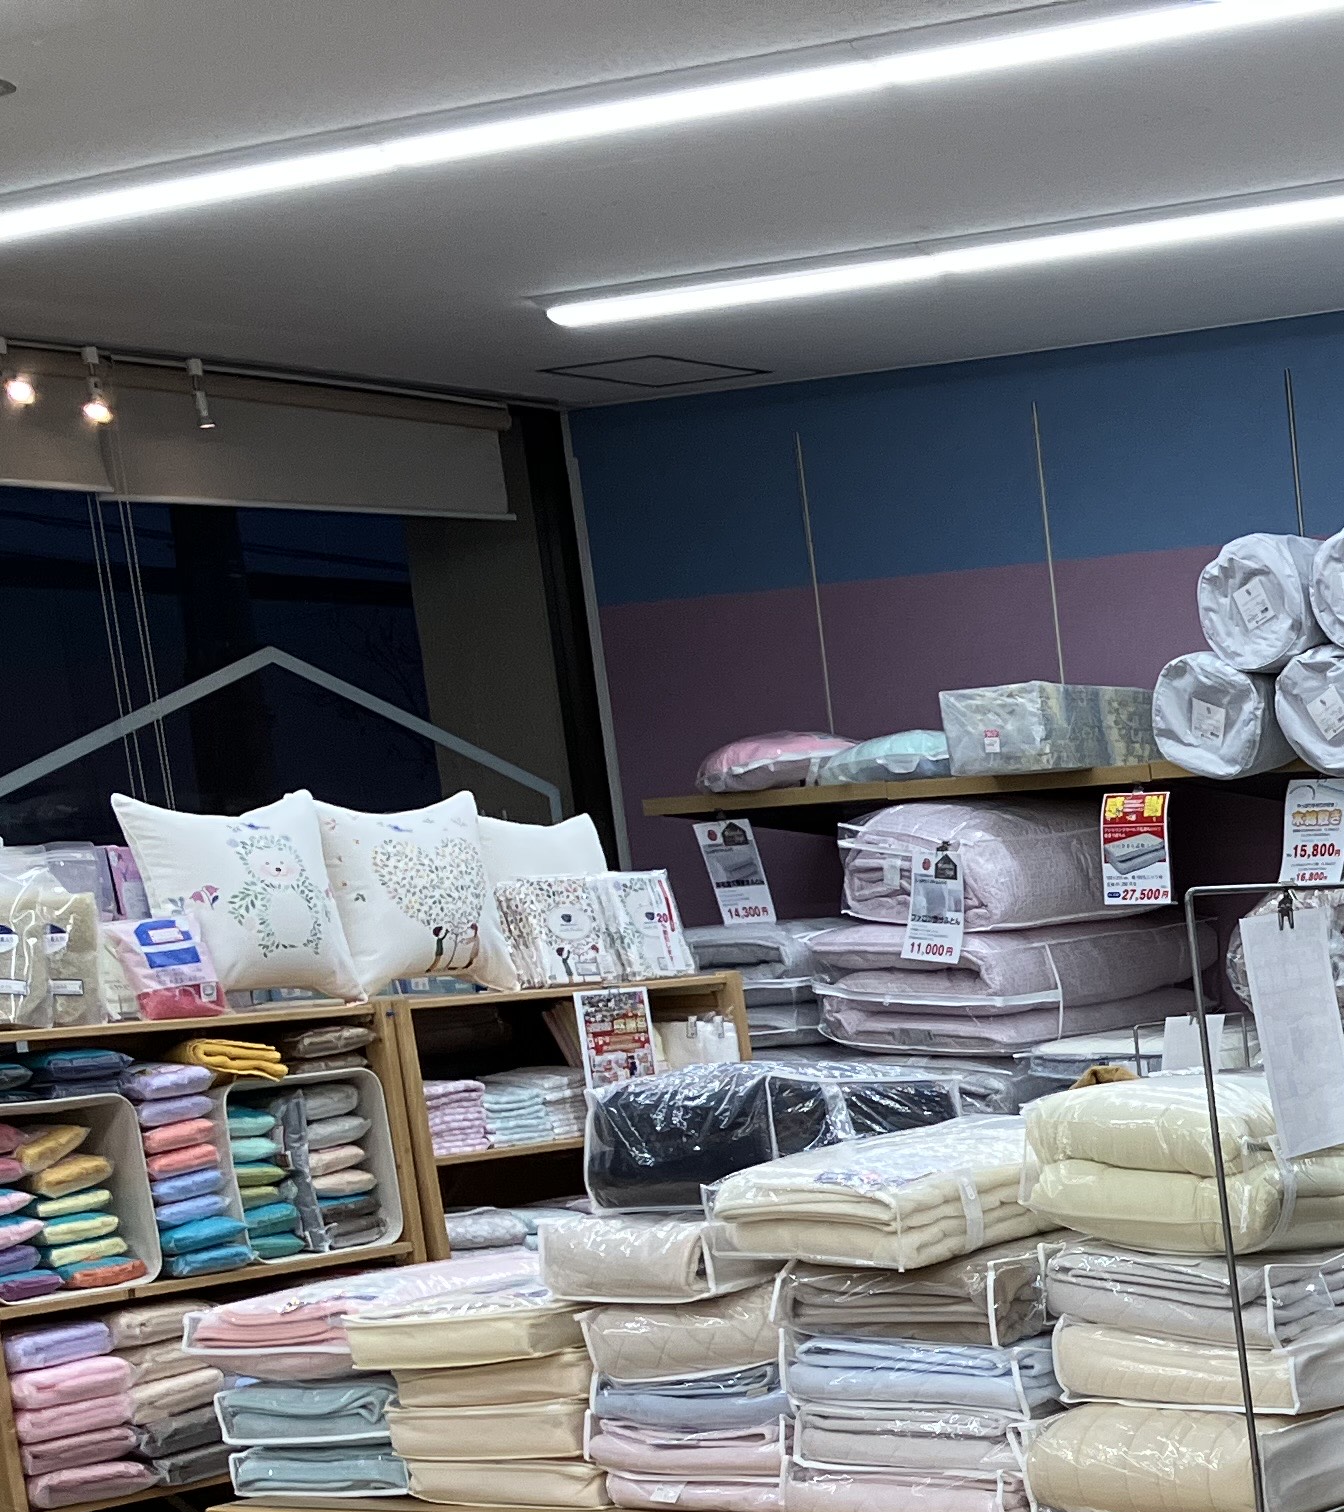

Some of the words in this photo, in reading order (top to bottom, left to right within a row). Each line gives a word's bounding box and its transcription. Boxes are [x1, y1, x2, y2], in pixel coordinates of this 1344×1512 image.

[1293, 842, 1341, 859] 15,800円
[1121, 888, 1170, 902] 27,500円
[727, 906, 769, 919] 14,300円
[909, 942, 954, 956] 11,000円
